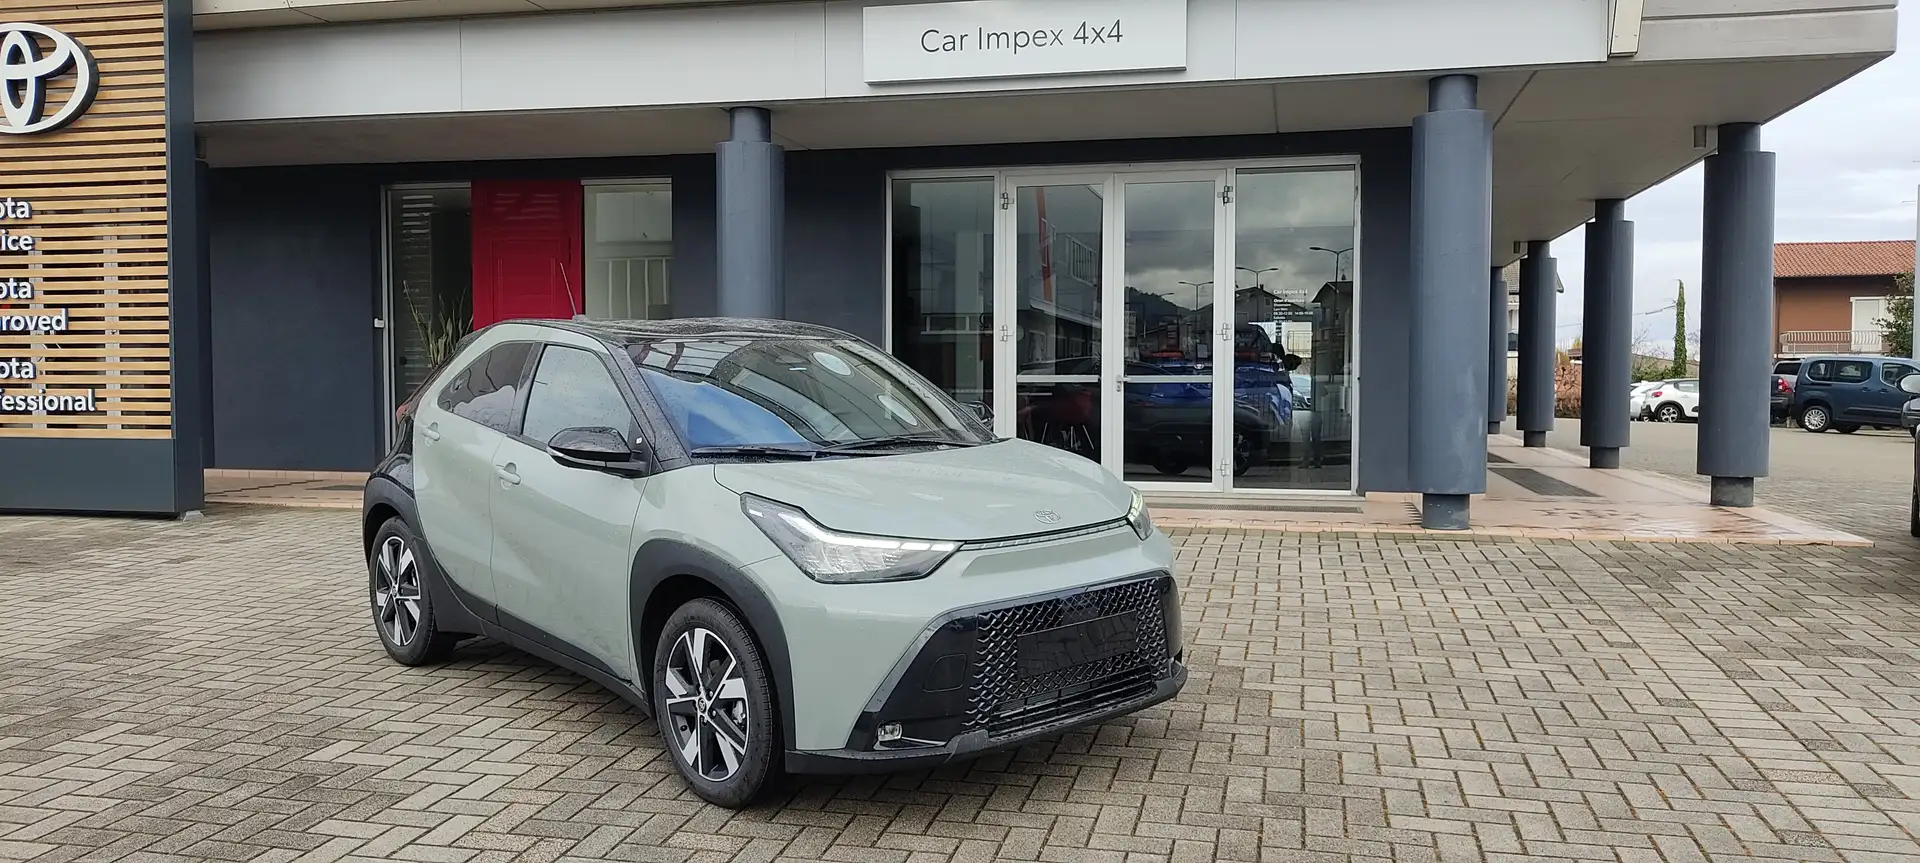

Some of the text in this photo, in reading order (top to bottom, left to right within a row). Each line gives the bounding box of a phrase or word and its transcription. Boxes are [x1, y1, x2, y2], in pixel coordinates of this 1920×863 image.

[921, 18, 1123, 55] Car Impex 4x4
